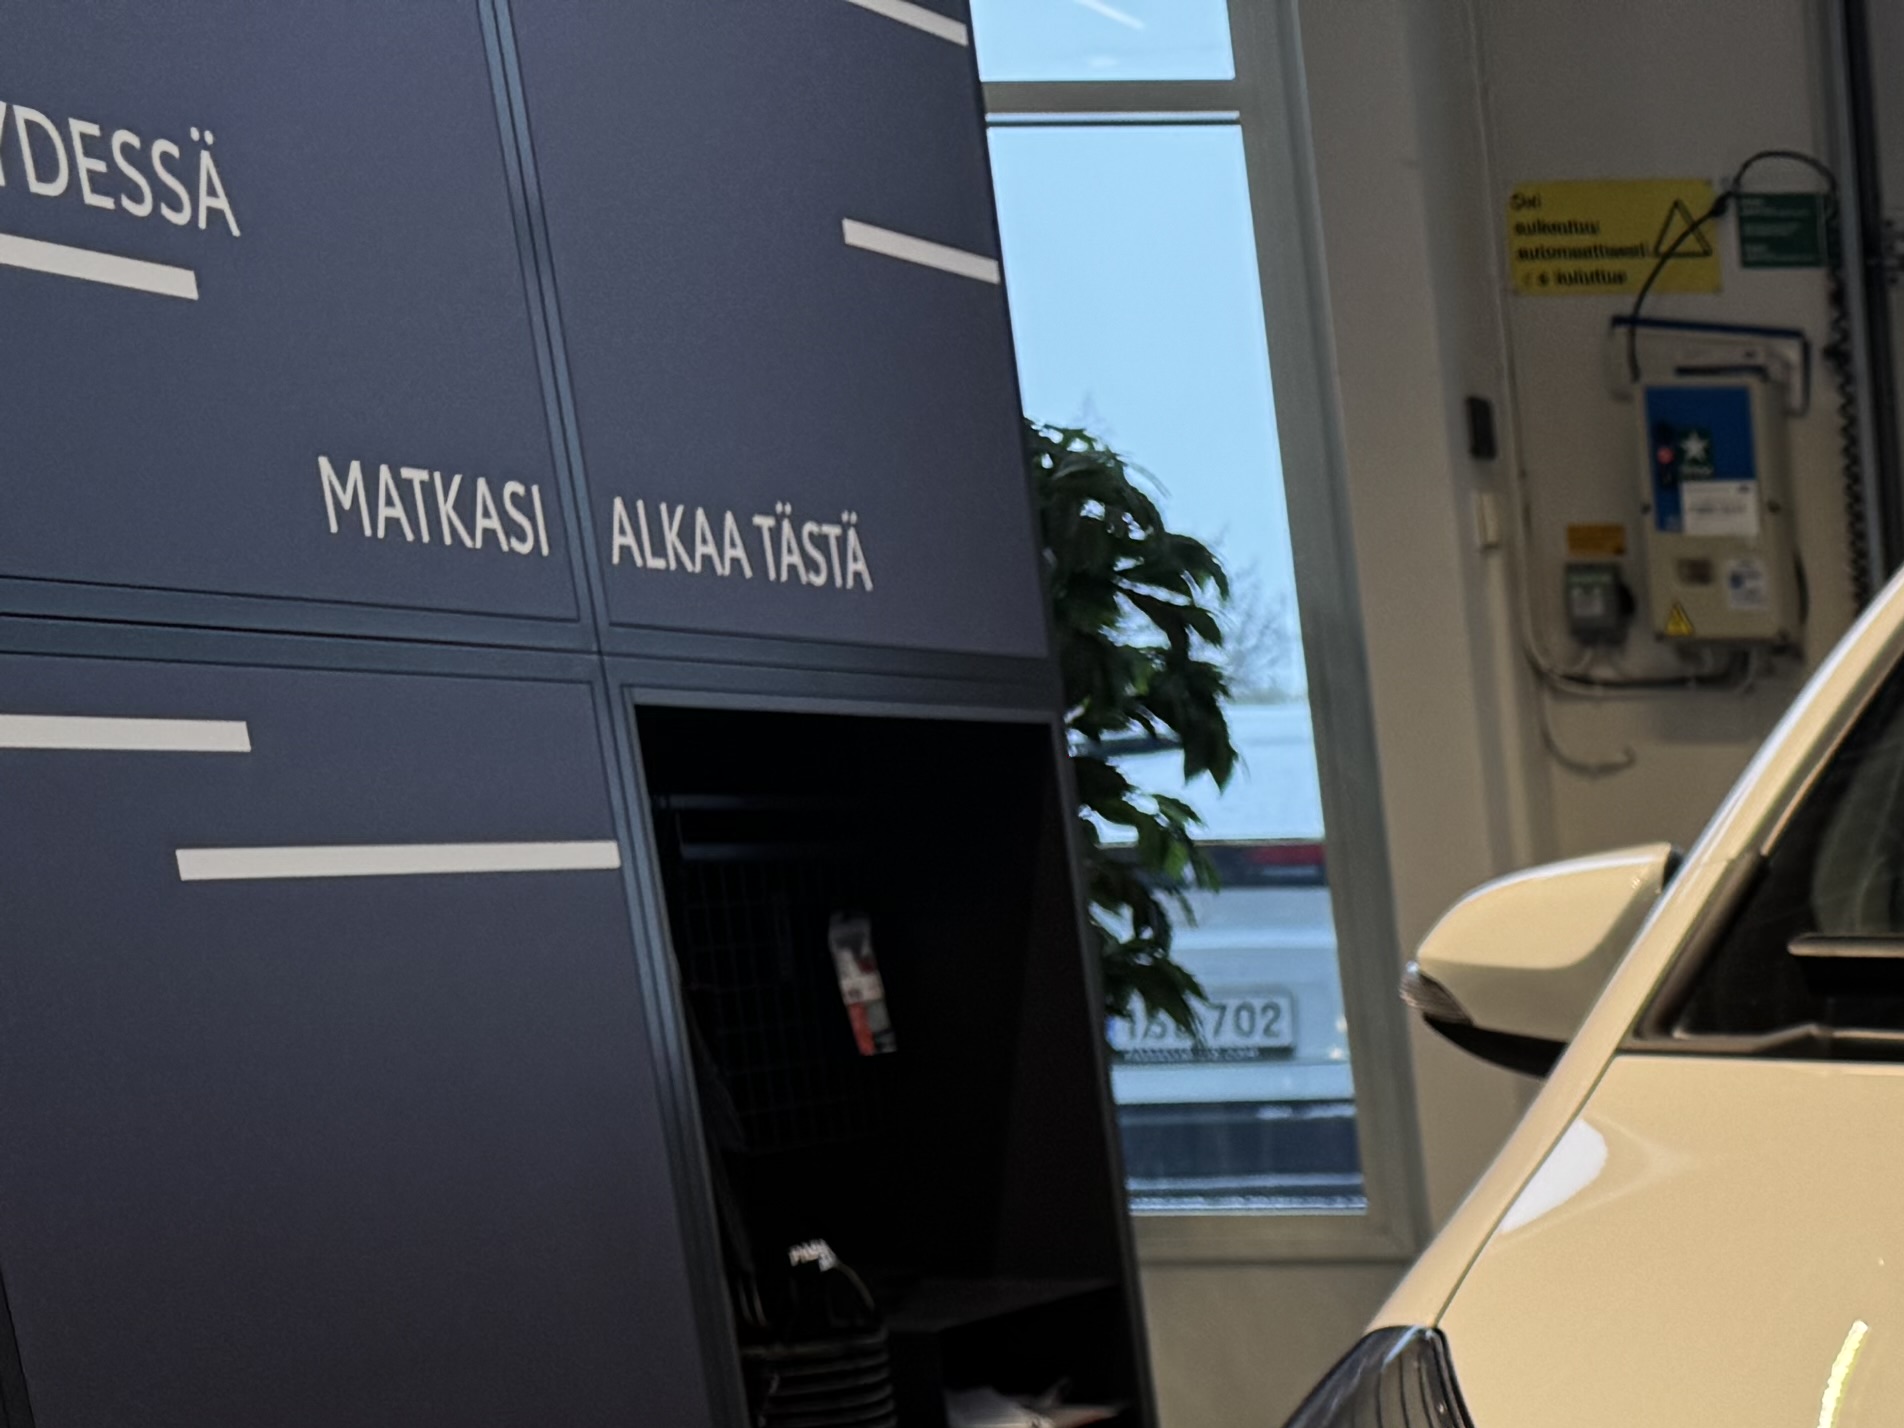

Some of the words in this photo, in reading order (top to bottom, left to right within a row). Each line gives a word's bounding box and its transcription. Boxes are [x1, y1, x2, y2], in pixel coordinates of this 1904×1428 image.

[318, 456, 548, 557] MATKASI
[613, 497, 753, 579] ALKAA
[753, 503, 872, 591] TÄSTÄ
